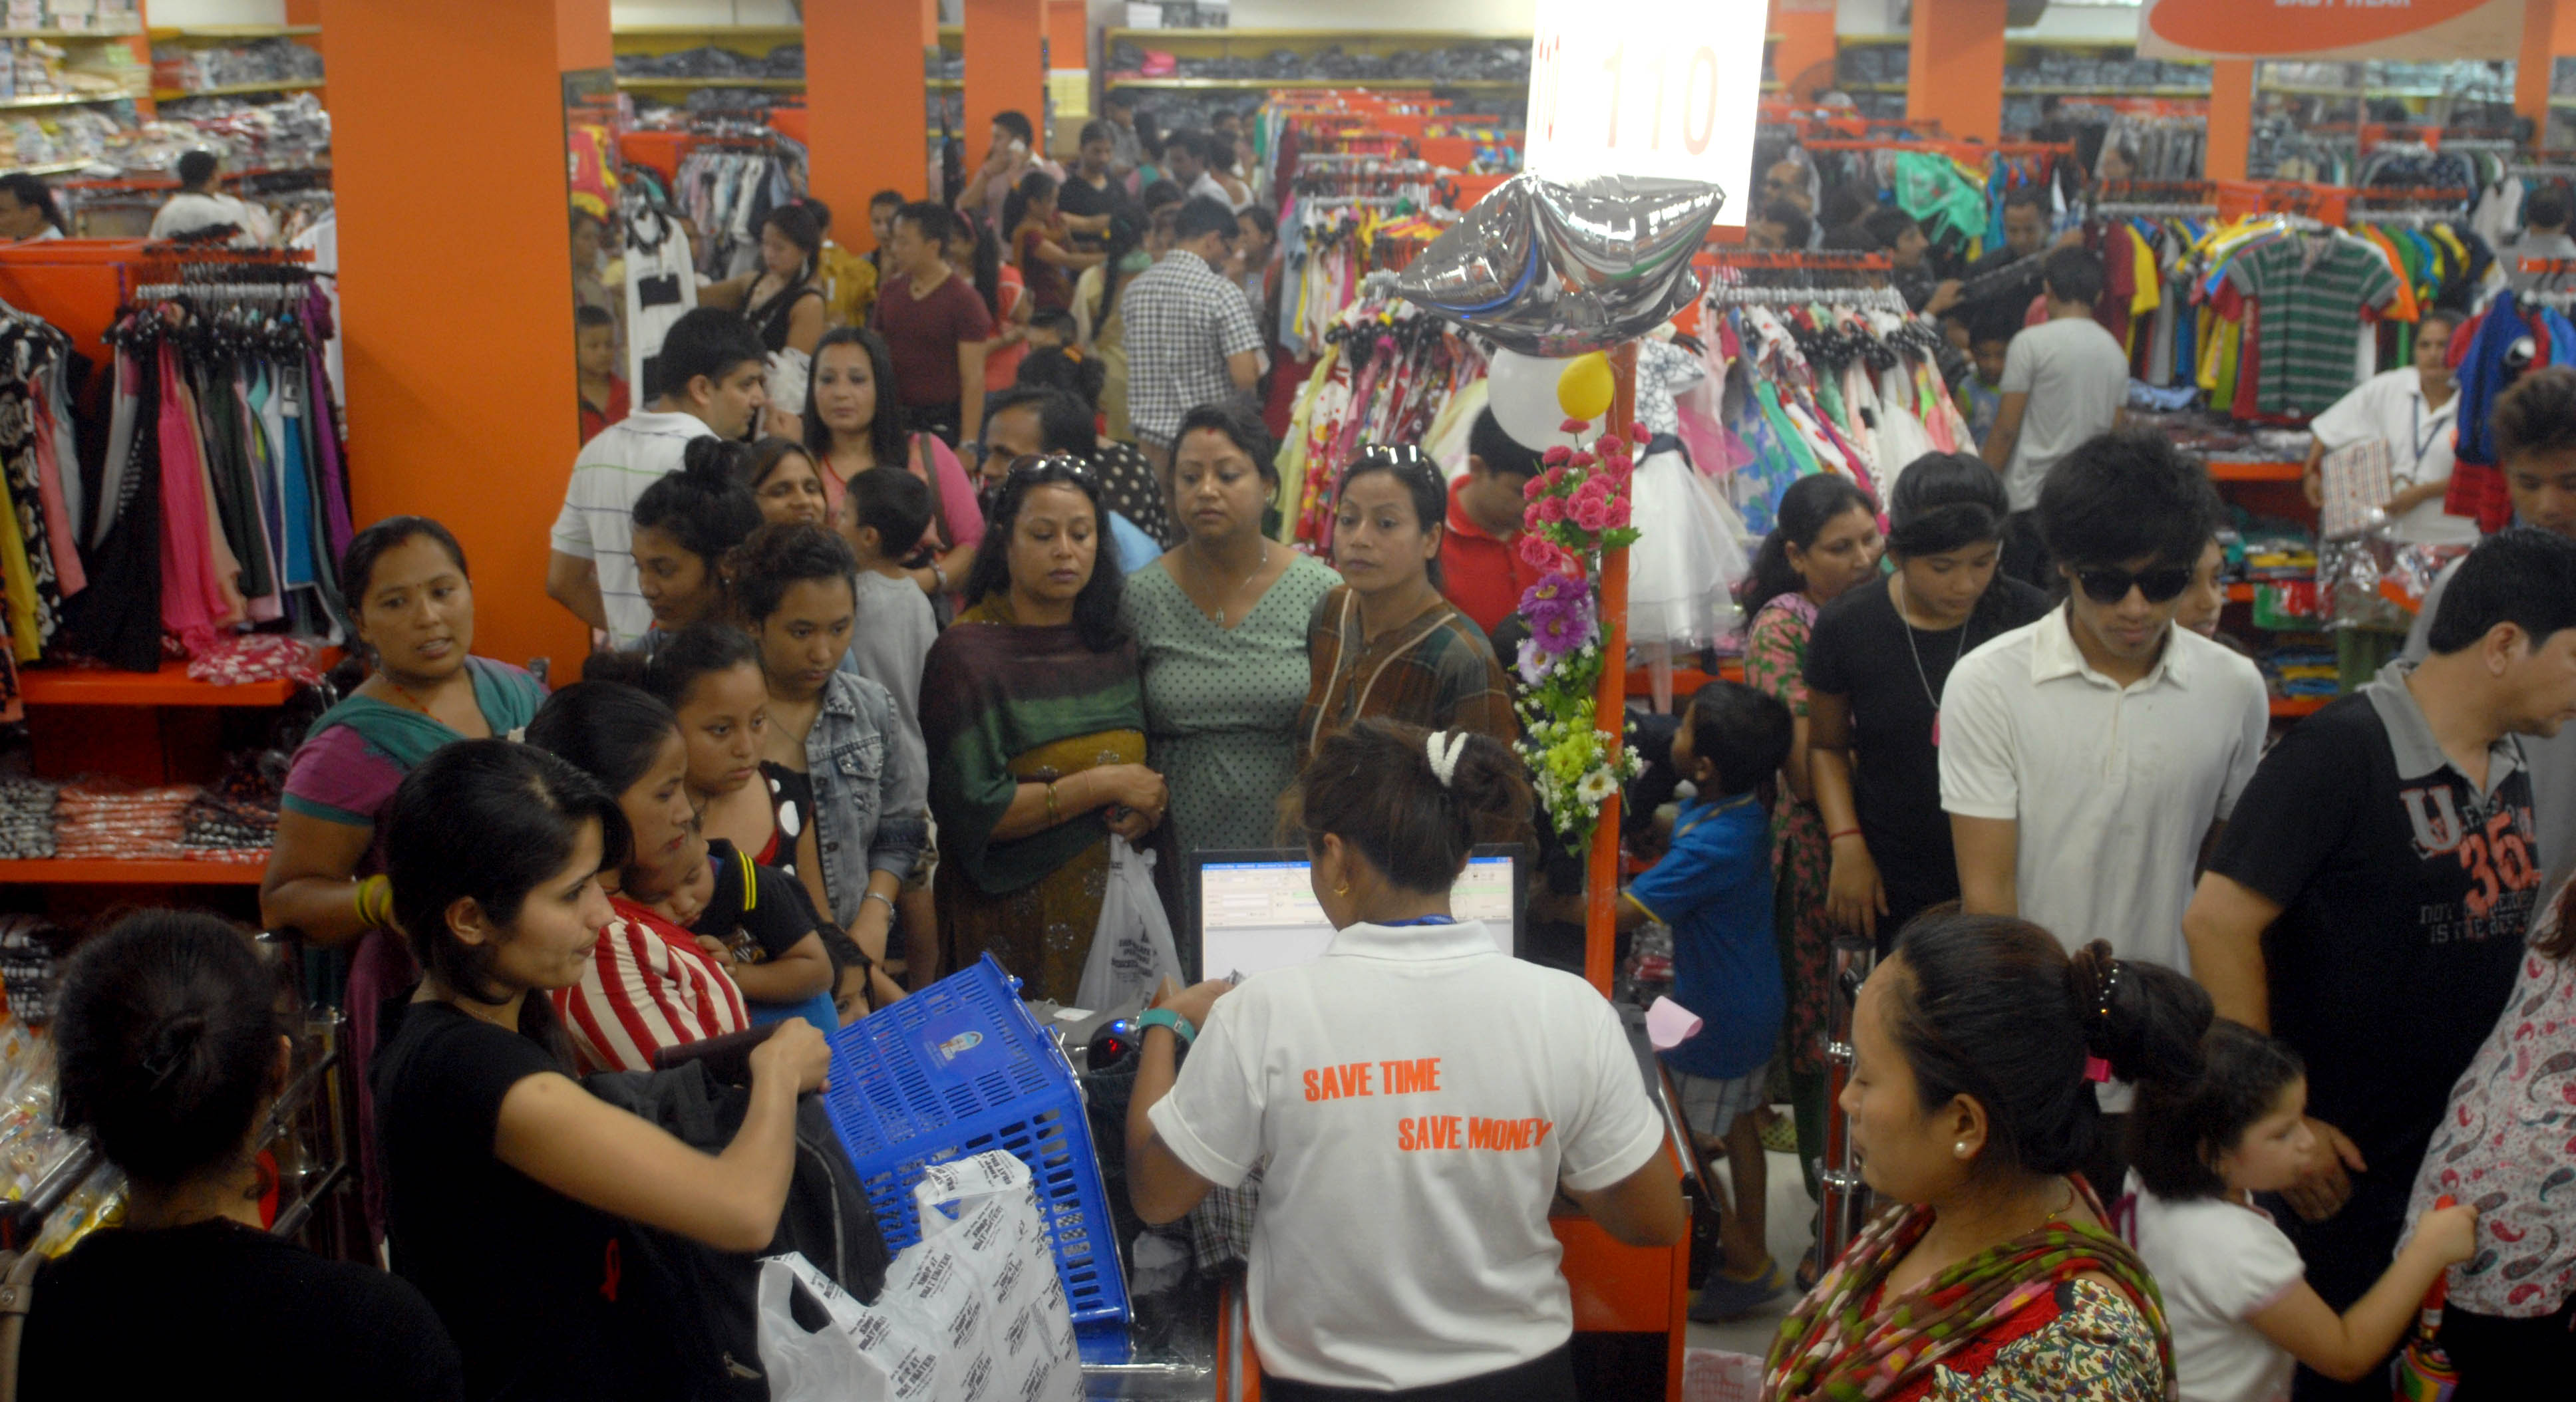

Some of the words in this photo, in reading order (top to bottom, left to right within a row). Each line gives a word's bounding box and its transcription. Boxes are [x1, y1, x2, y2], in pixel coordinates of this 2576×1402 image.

[1604, 38, 1718, 155] 110
[1303, 1063, 1373, 1102] SAVE
[1380, 1058, 1440, 1095] TIME
[1398, 1115, 1462, 1151] SAVE
[1468, 1117, 1553, 1151] MONEY
